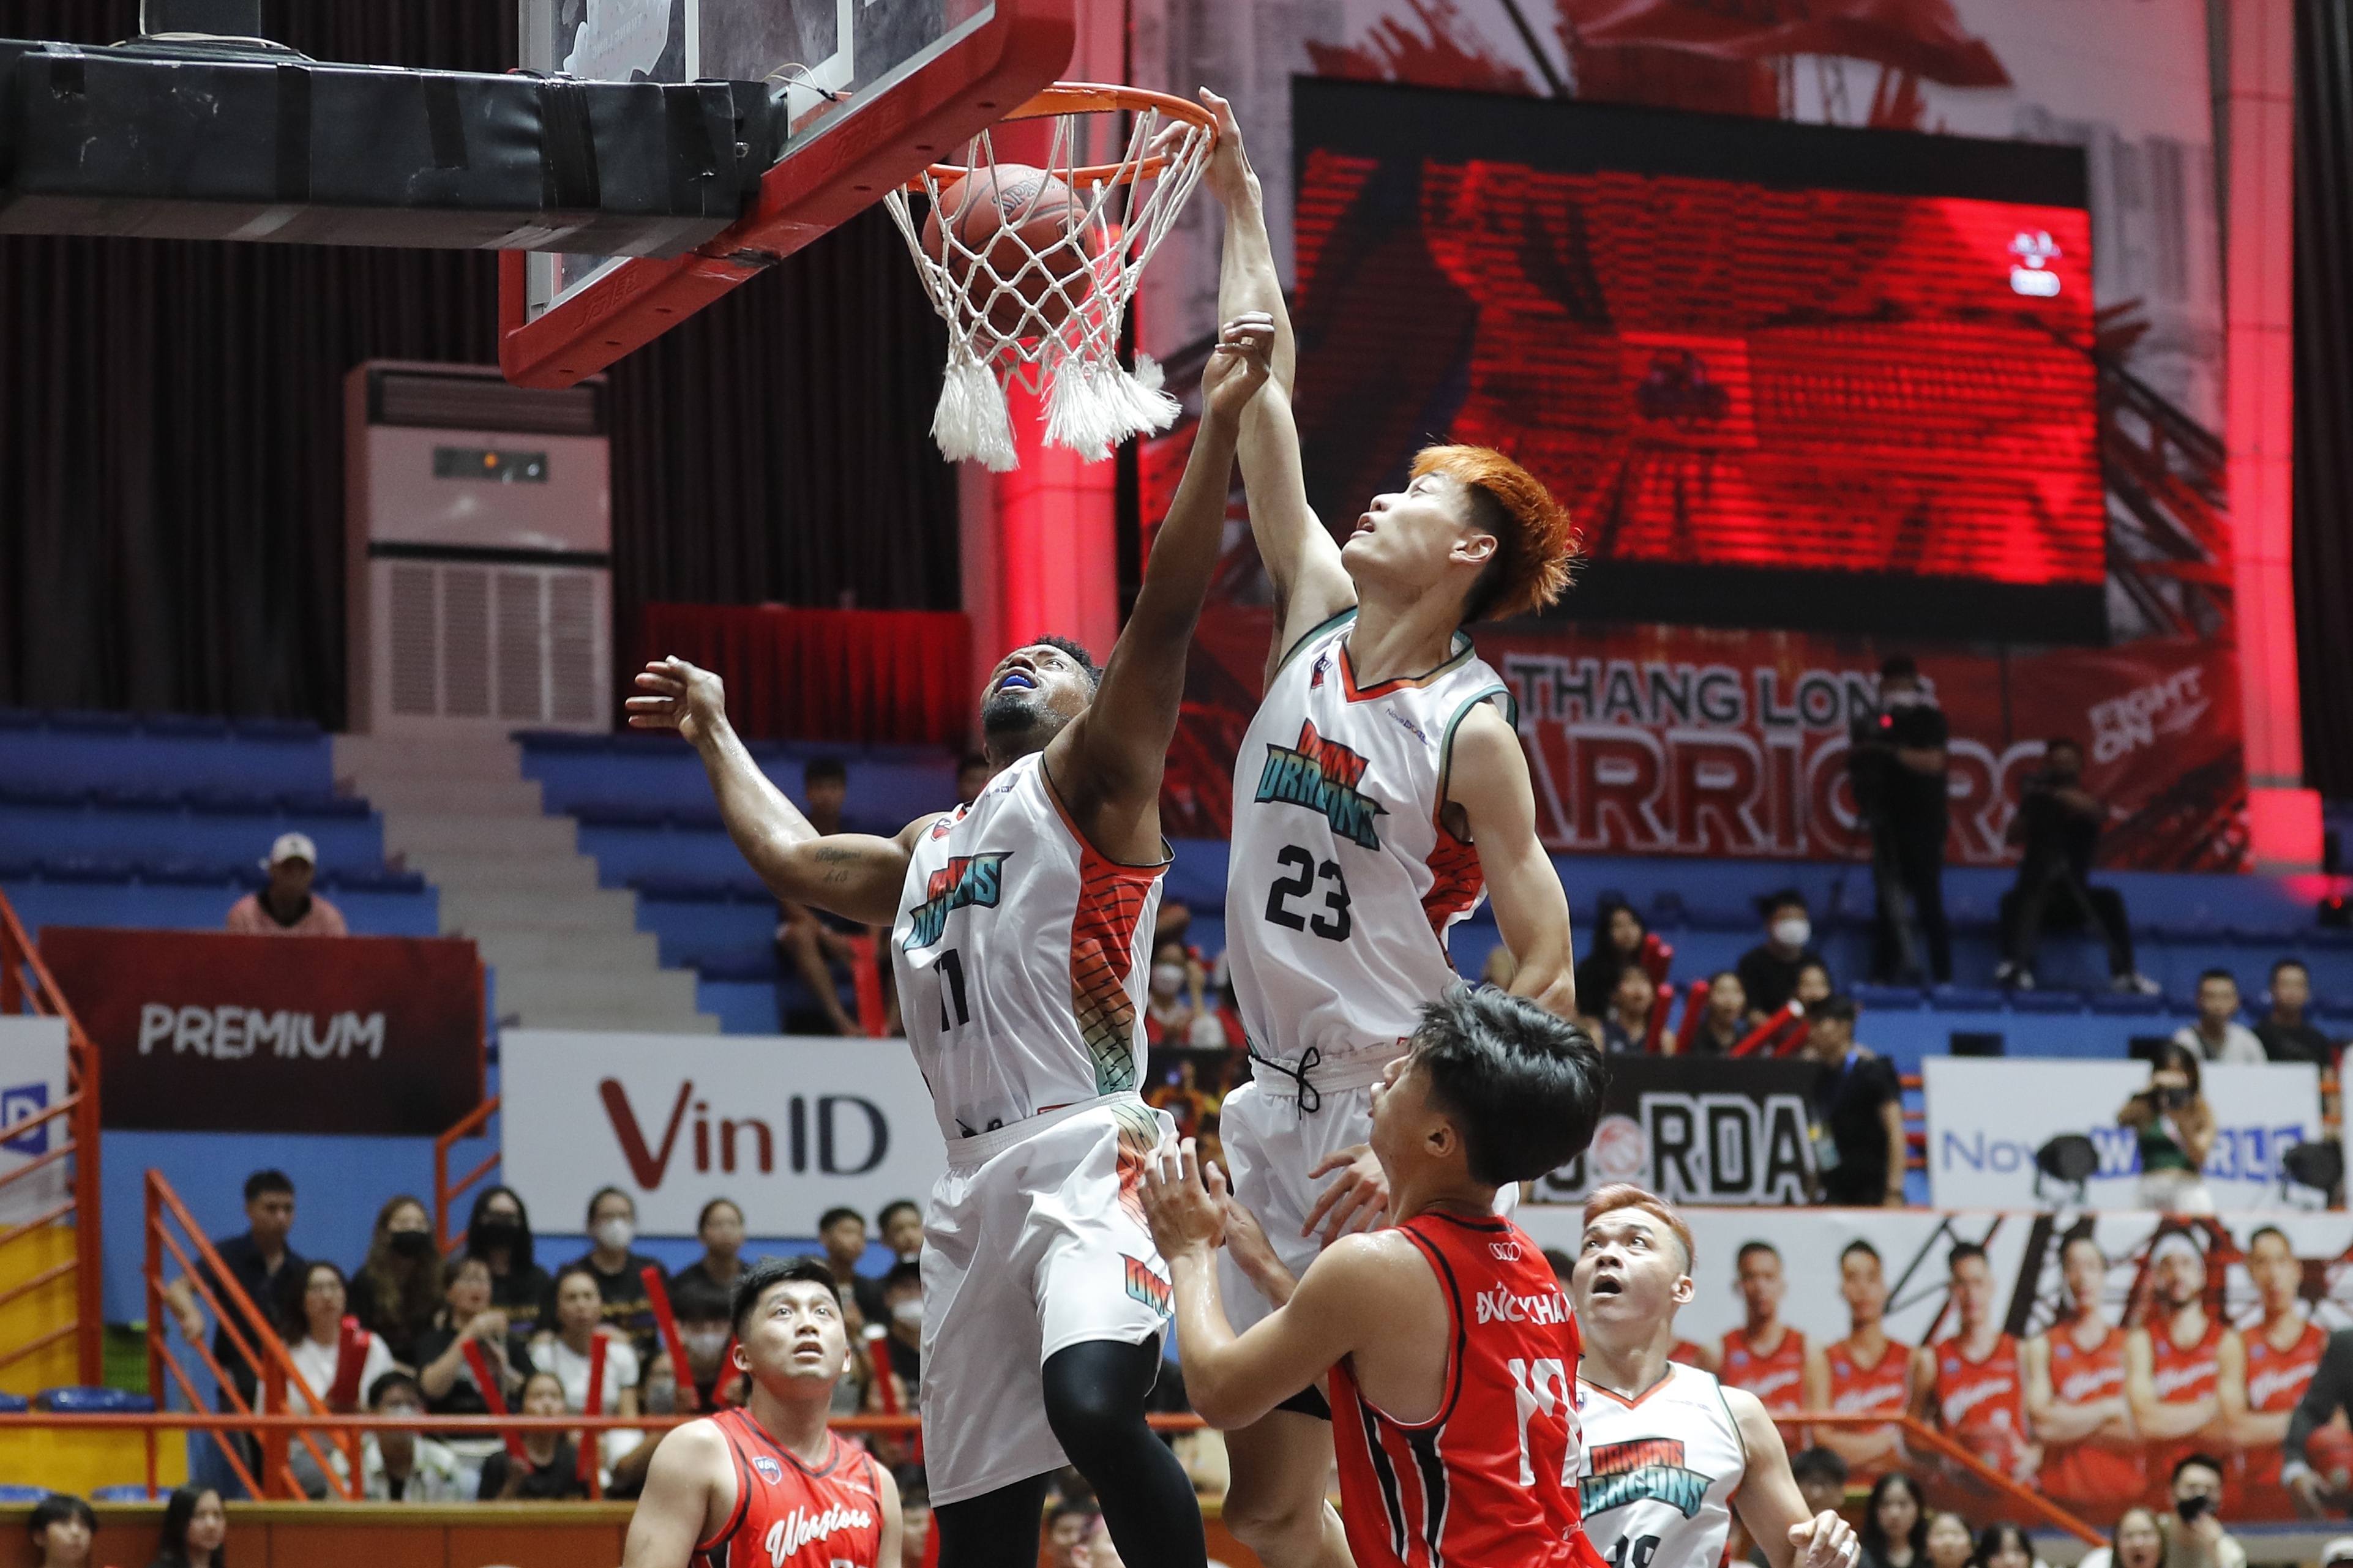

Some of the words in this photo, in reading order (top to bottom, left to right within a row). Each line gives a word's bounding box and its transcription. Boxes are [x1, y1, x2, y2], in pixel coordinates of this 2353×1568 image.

[1504, 652, 1746, 726] THANG
[1754, 667, 1940, 732] LON
[1265, 845, 1352, 943] 23
[138, 1002, 386, 1059] PREMIUM
[935, 949, 969, 1032] 11
[599, 1077, 889, 1191] VinID
